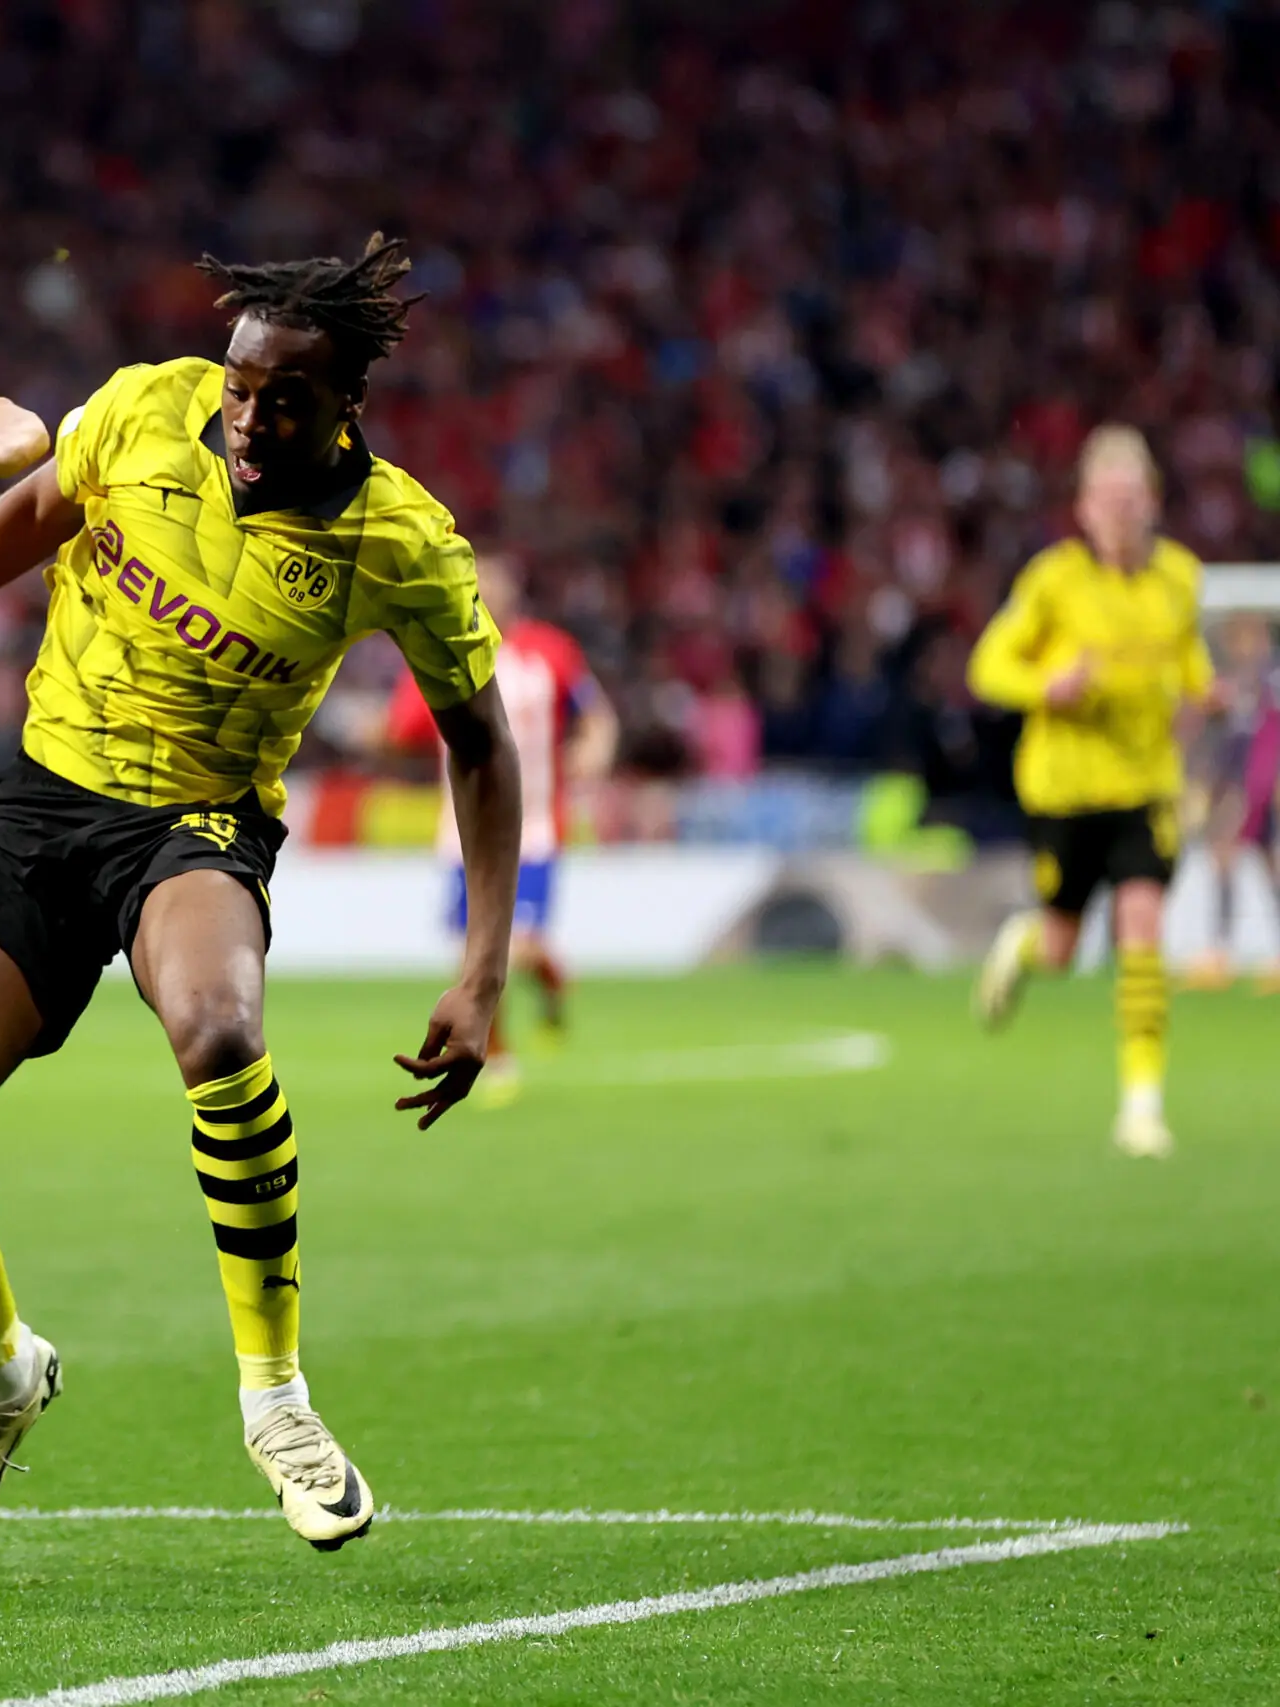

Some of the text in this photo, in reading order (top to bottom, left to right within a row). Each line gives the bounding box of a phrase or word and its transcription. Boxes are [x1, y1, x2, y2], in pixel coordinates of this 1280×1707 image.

[283, 556, 328, 598] BVB
[288, 587, 306, 603] 09
[116, 556, 300, 684] EVONIK
